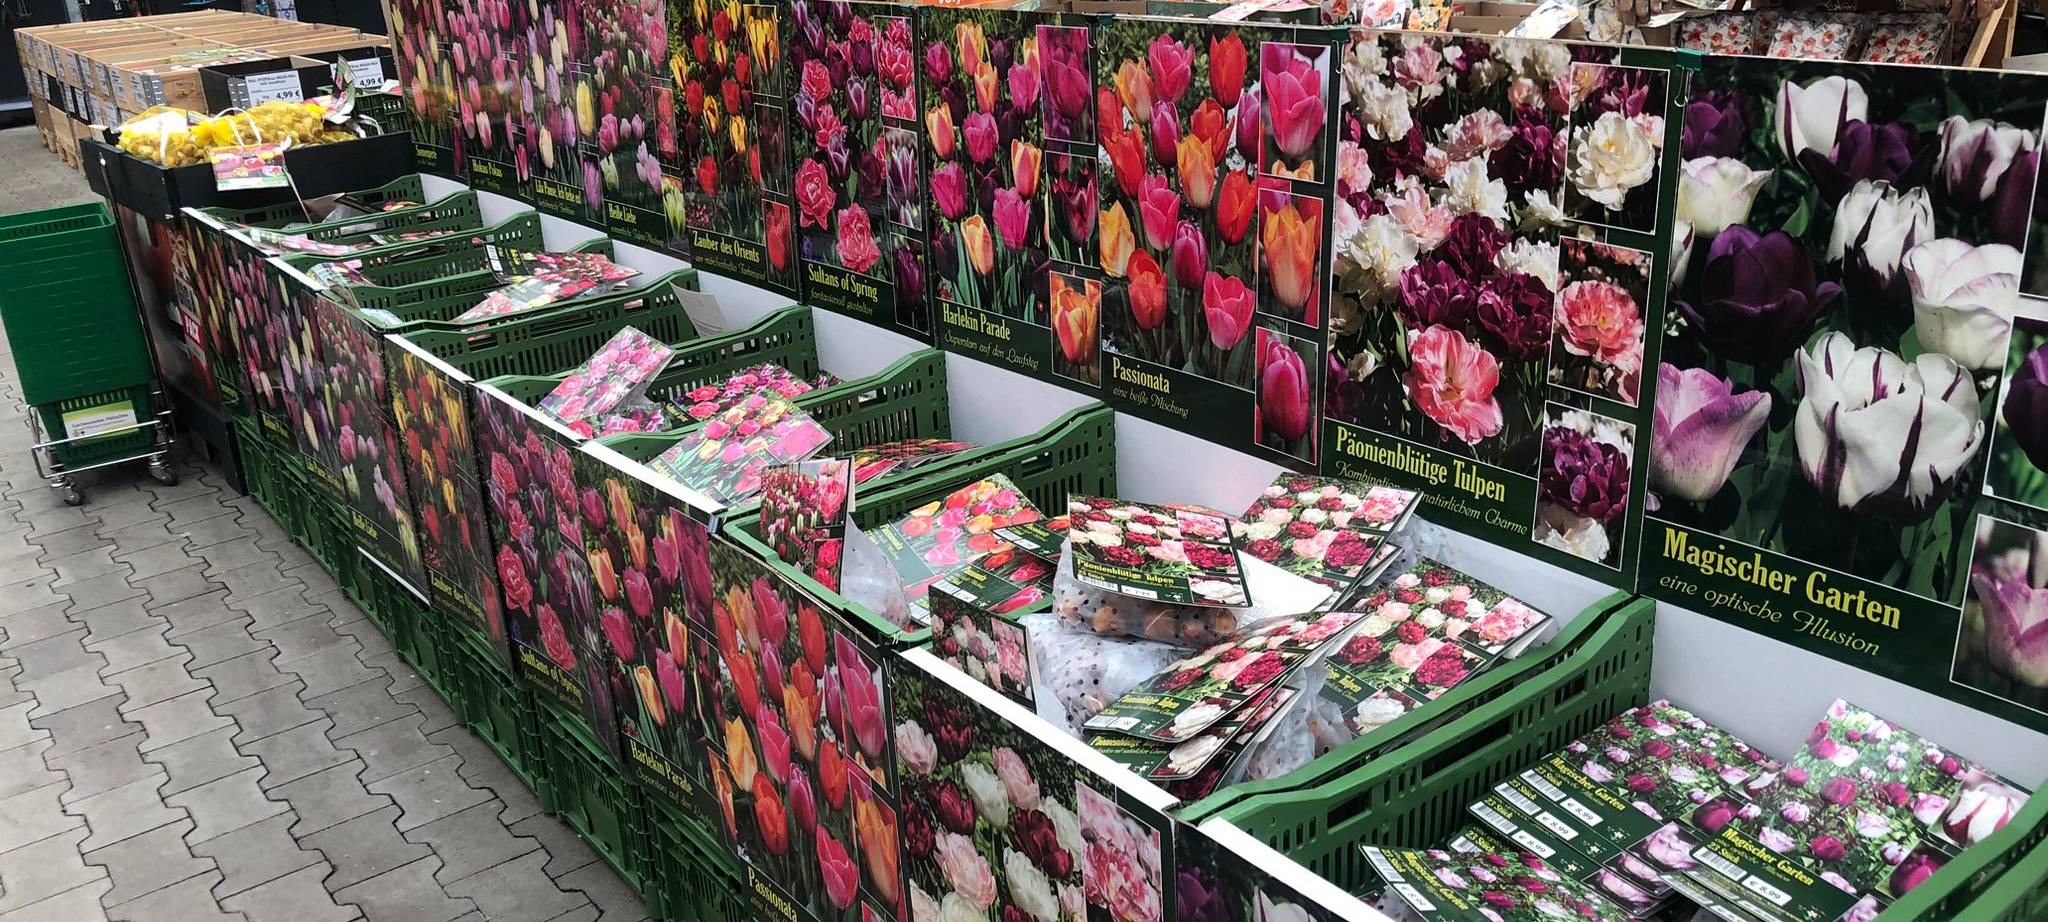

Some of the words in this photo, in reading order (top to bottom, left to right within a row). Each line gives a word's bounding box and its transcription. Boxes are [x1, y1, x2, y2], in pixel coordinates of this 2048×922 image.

[276, 91, 293, 100] 4,99
[359, 78, 376, 87] 4,99
[693, 230, 719, 252] Zauber
[720, 236, 733, 256] des
[733, 240, 760, 263] Orients
[808, 263, 839, 288] Sultans
[841, 273, 850, 291] of
[850, 274, 878, 303] Spring
[943, 302, 979, 331] Harlekin
[980, 313, 1011, 341] Parade
[944, 329, 978, 350] Superstars
[979, 342, 992, 357] auf
[991, 344, 1004, 359] den
[1006, 347, 1039, 372] Laufsteg
[1112, 356, 1170, 394] Passionata
[1113, 387, 1128, 399] eine
[1129, 387, 1149, 406] heiße
[1150, 393, 1189, 420] Mischung
[1336, 426, 1448, 486] Päonienblütige
[1453, 459, 1505, 502] Tulpen
[1484, 508, 1528, 536] Charme
[1077, 558, 1142, 580] Päonienblütige
[1144, 573, 1174, 584] Tulpen
[1662, 527, 1797, 595] Magischer
[1805, 570, 1901, 630] Garten
[1659, 575, 1698, 596] eine
[1704, 589, 1783, 623] optische
[1792, 610, 1880, 656] Illusion
[519, 645, 550, 676] Sultans
[550, 665, 559, 682] of
[559, 668, 584, 704] Spring
[629, 738, 667, 778] Harlekin
[664, 760, 694, 796] Parade
[1534, 764, 1547, 775] 23
[1546, 772, 1563, 788] Stück
[1508, 778, 1521, 788] 23
[1519, 785, 1537, 801] Stück
[1550, 757, 1596, 790] Magischer
[1594, 787, 1626, 811] Garten
[1484, 797, 1497, 807] 23
[1494, 804, 1513, 820] Stück
[1575, 807, 1594, 821] 8,99
[1465, 830, 1479, 840] 23
[1475, 836, 1495, 853] Stück
[1550, 821, 1569, 835] 8,99
[1526, 839, 1547, 853] 8,99
[1706, 841, 1721, 851] 23
[1719, 848, 1740, 864] Stück
[1721, 827, 1778, 864] Magischer
[1776, 859, 1815, 887] Garten
[747, 865, 798, 922] Passionata
[1759, 885, 1782, 899] 8,99
